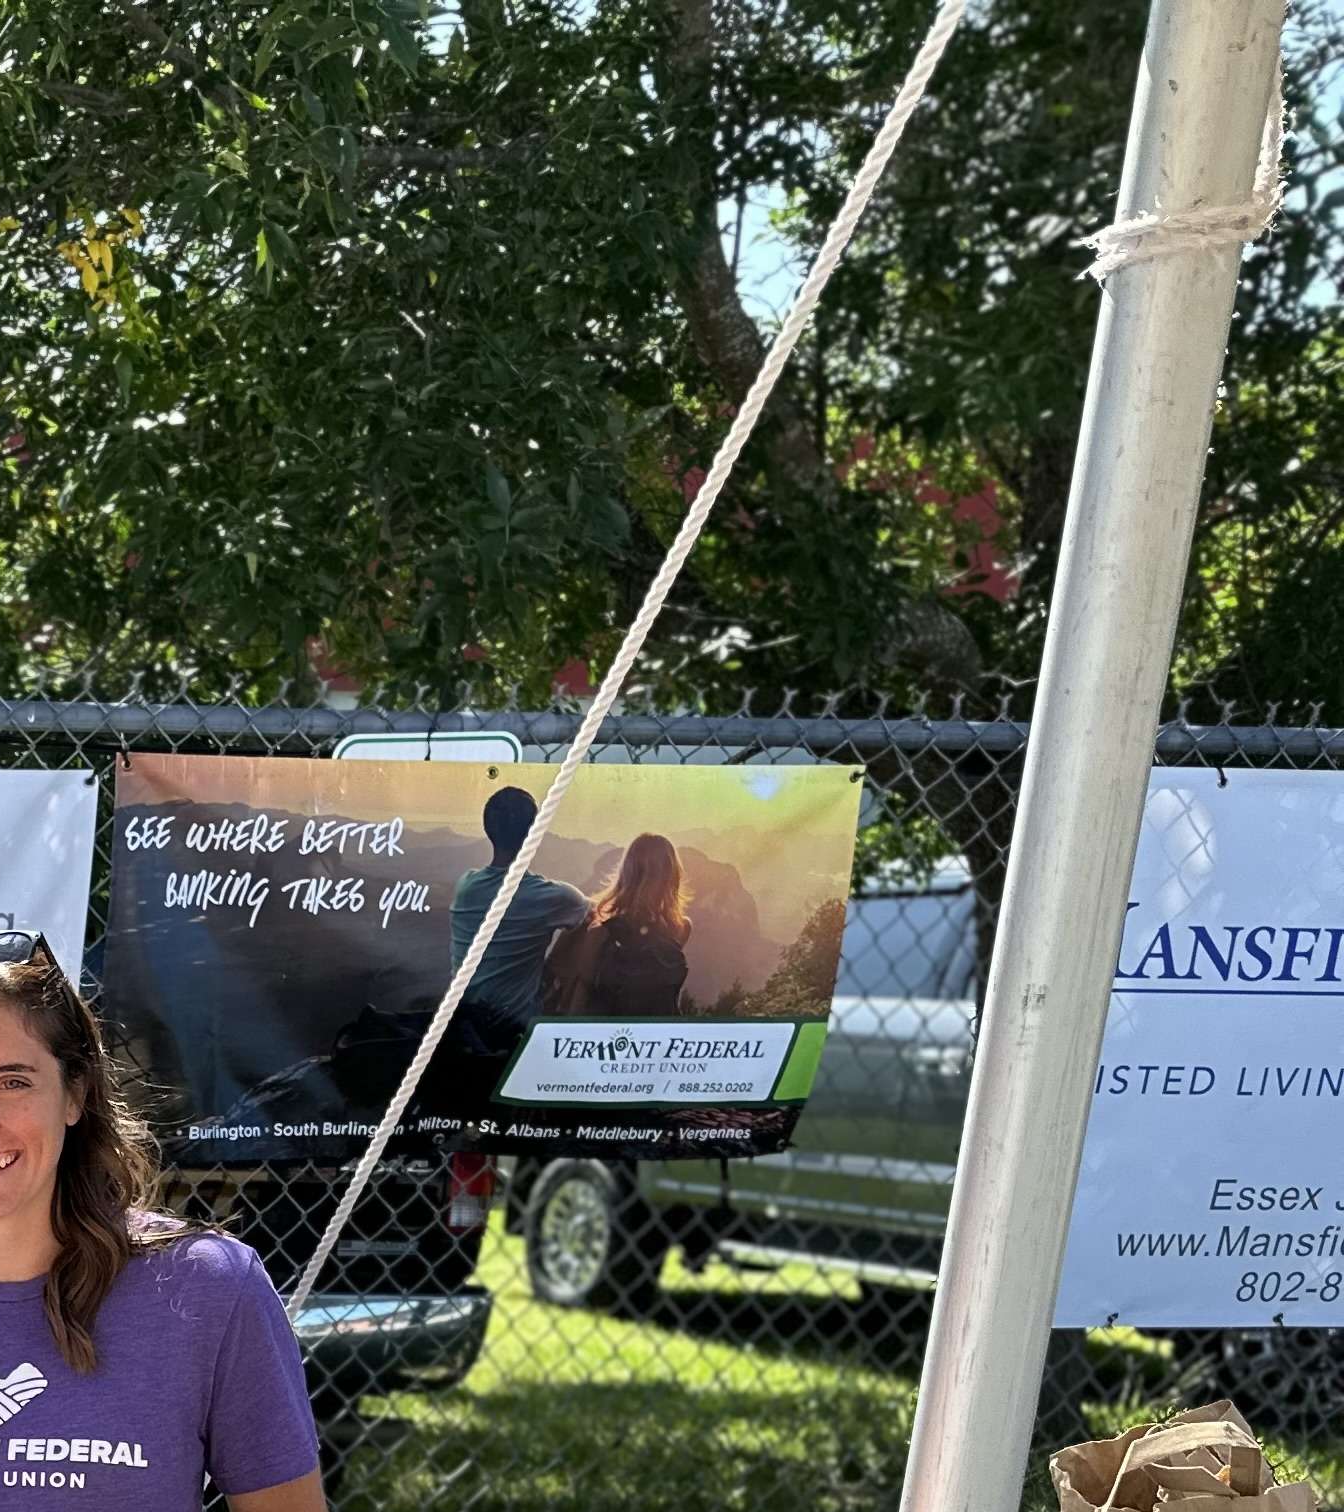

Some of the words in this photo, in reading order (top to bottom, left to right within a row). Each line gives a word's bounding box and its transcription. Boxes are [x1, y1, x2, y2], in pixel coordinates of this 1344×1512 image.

[125, 815, 176, 852] SEE
[185, 813, 290, 854] WHERE
[298, 816, 405, 857] BETTER
[280, 875, 365, 916] TAKES
[552, 1034, 662, 1062] VERMONT
[664, 1037, 765, 1059] FEDERAL
[600, 1062, 656, 1073] CREDIT
[659, 1062, 708, 1073] UNION
[536, 1081, 655, 1095] vermontfederal.org
[678, 1082, 754, 1094] 888.252.0202
[189, 1123, 261, 1141] Burlington
[273, 1122, 318, 1137] South
[417, 1117, 462, 1133] Milton
[478, 1118, 502, 1135] St.
[506, 1123, 561, 1139] Albans
[576, 1124, 664, 1143] Middlebury
[678, 1125, 752, 1143] Vergennes
[1209, 1178, 1323, 1212] Essex
[7, 1437, 149, 1468] FEDERAL
[3, 1471, 87, 1489] UNION
